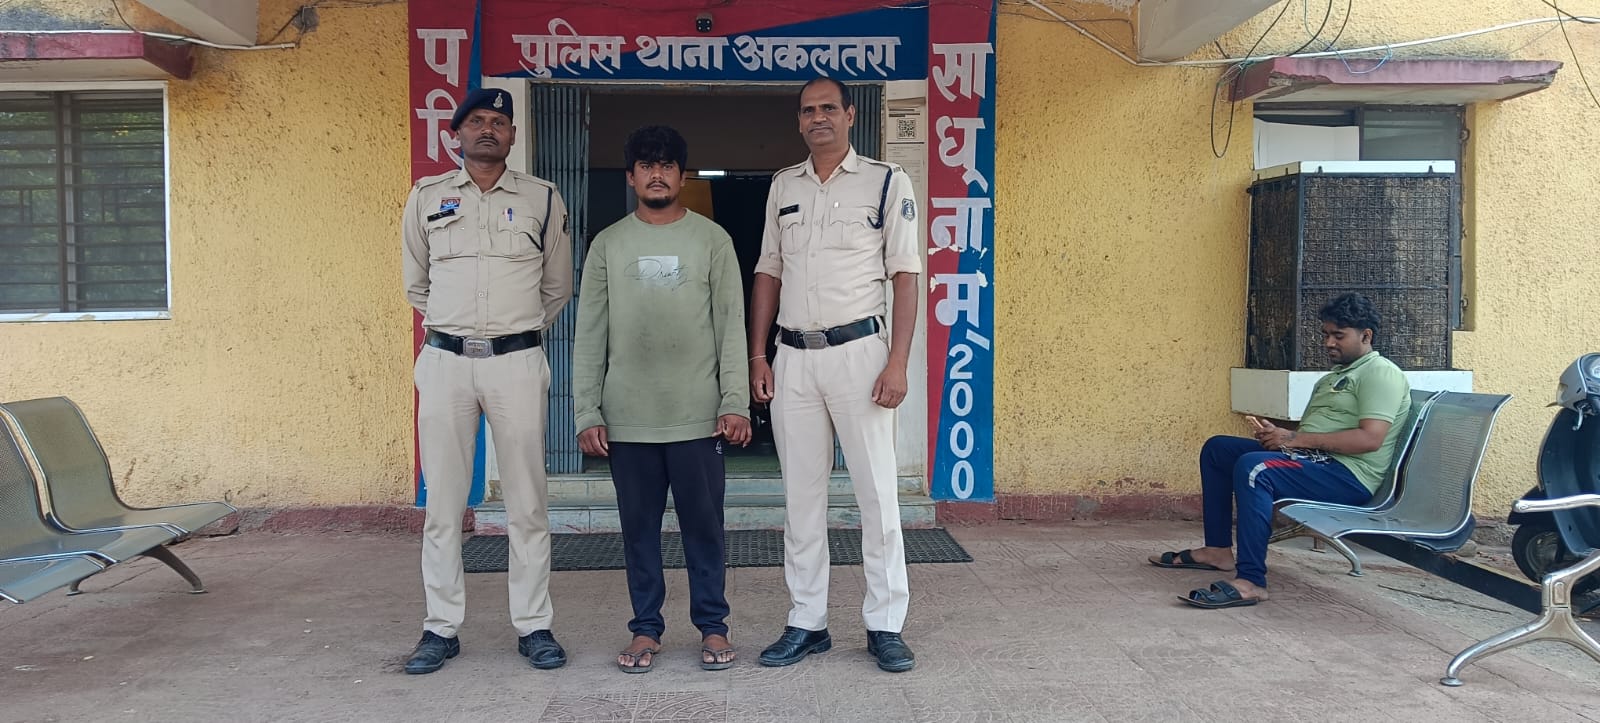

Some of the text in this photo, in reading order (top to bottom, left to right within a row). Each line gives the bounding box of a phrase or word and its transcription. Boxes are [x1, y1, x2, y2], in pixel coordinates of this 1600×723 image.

[512, 18, 901, 79] पुलिस थाना अकलतरा
[949, 343, 975, 500] 2000
